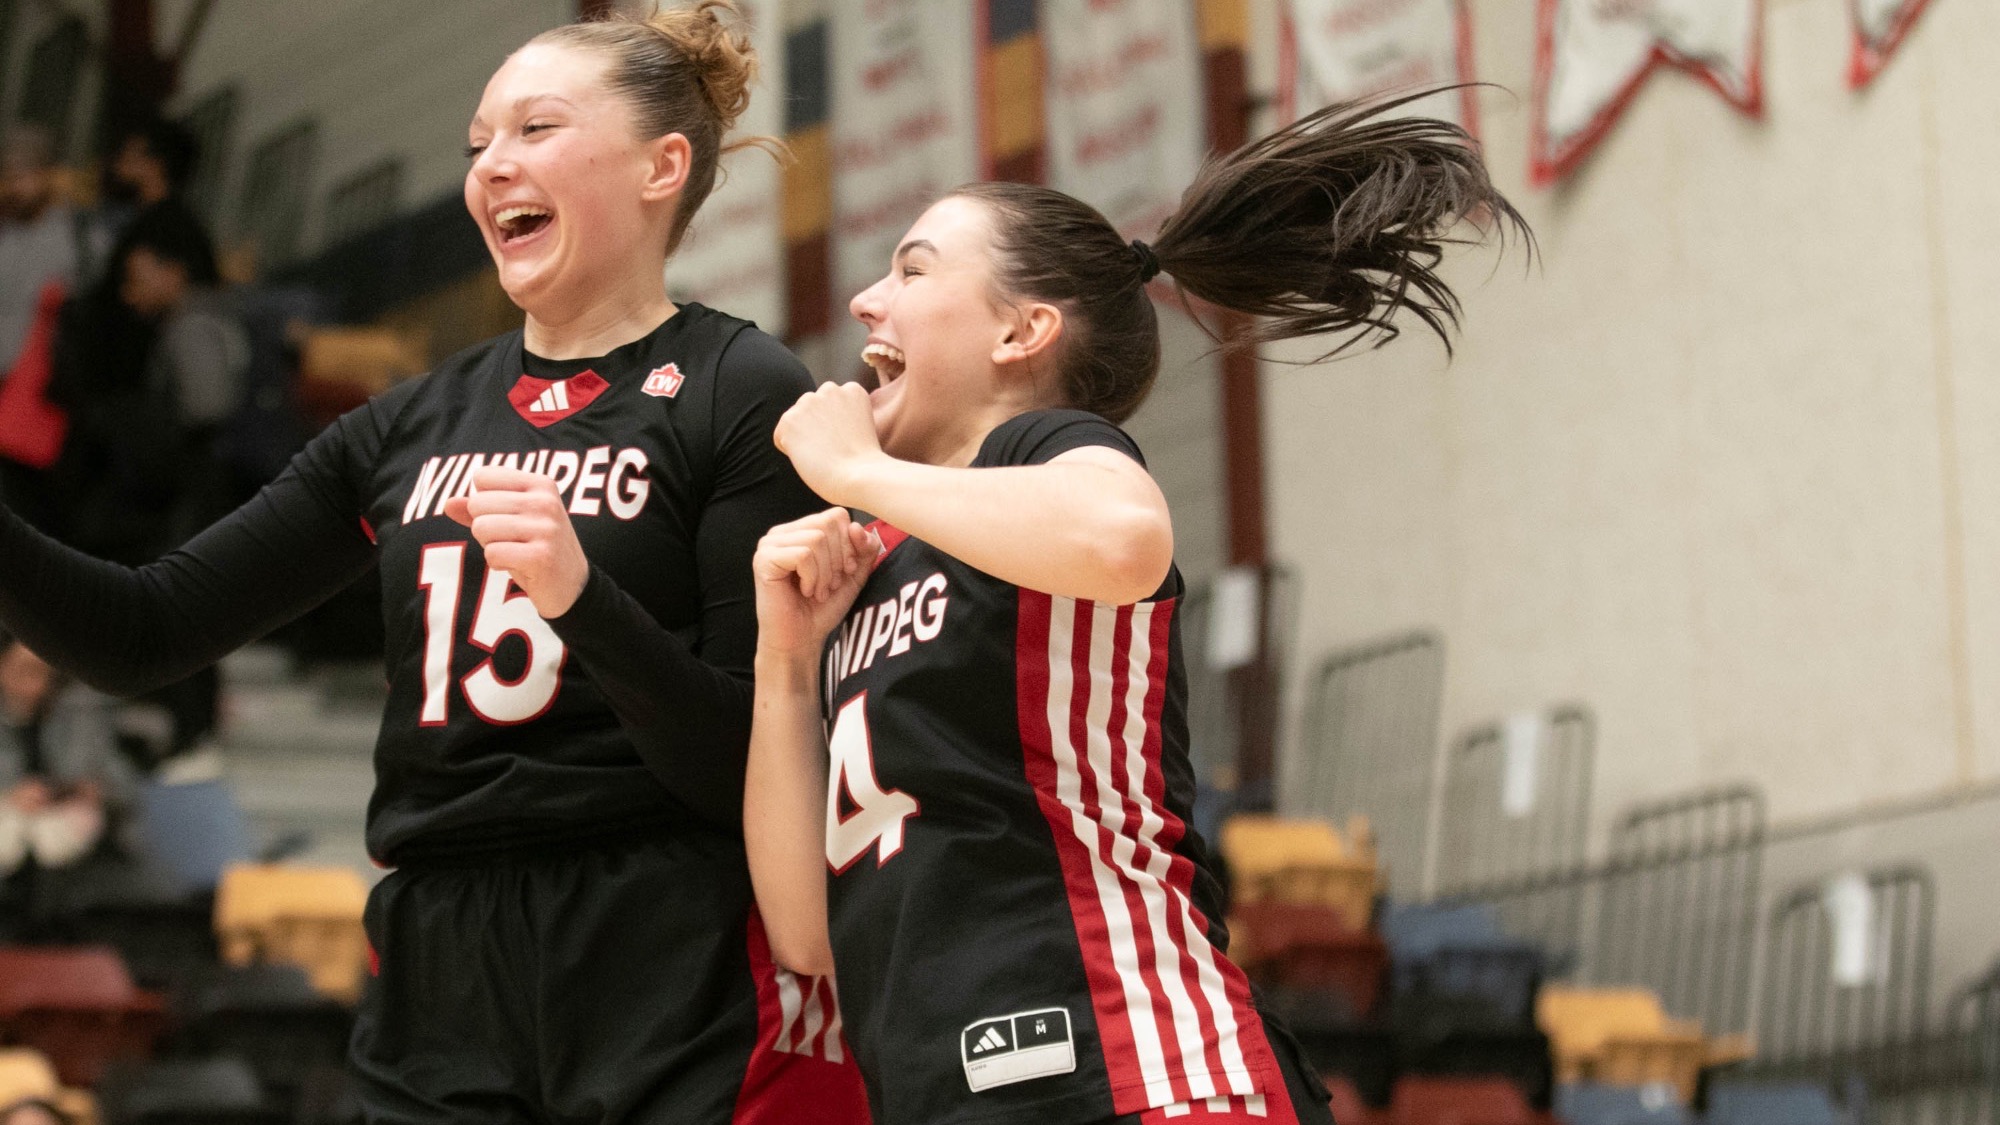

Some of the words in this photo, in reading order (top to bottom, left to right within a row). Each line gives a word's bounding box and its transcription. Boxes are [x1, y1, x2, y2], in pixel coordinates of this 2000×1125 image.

[646, 374, 679, 393] CW
[417, 541, 568, 727] 15
[822, 688, 921, 877] 4
[1035, 1024, 1047, 1035] M
